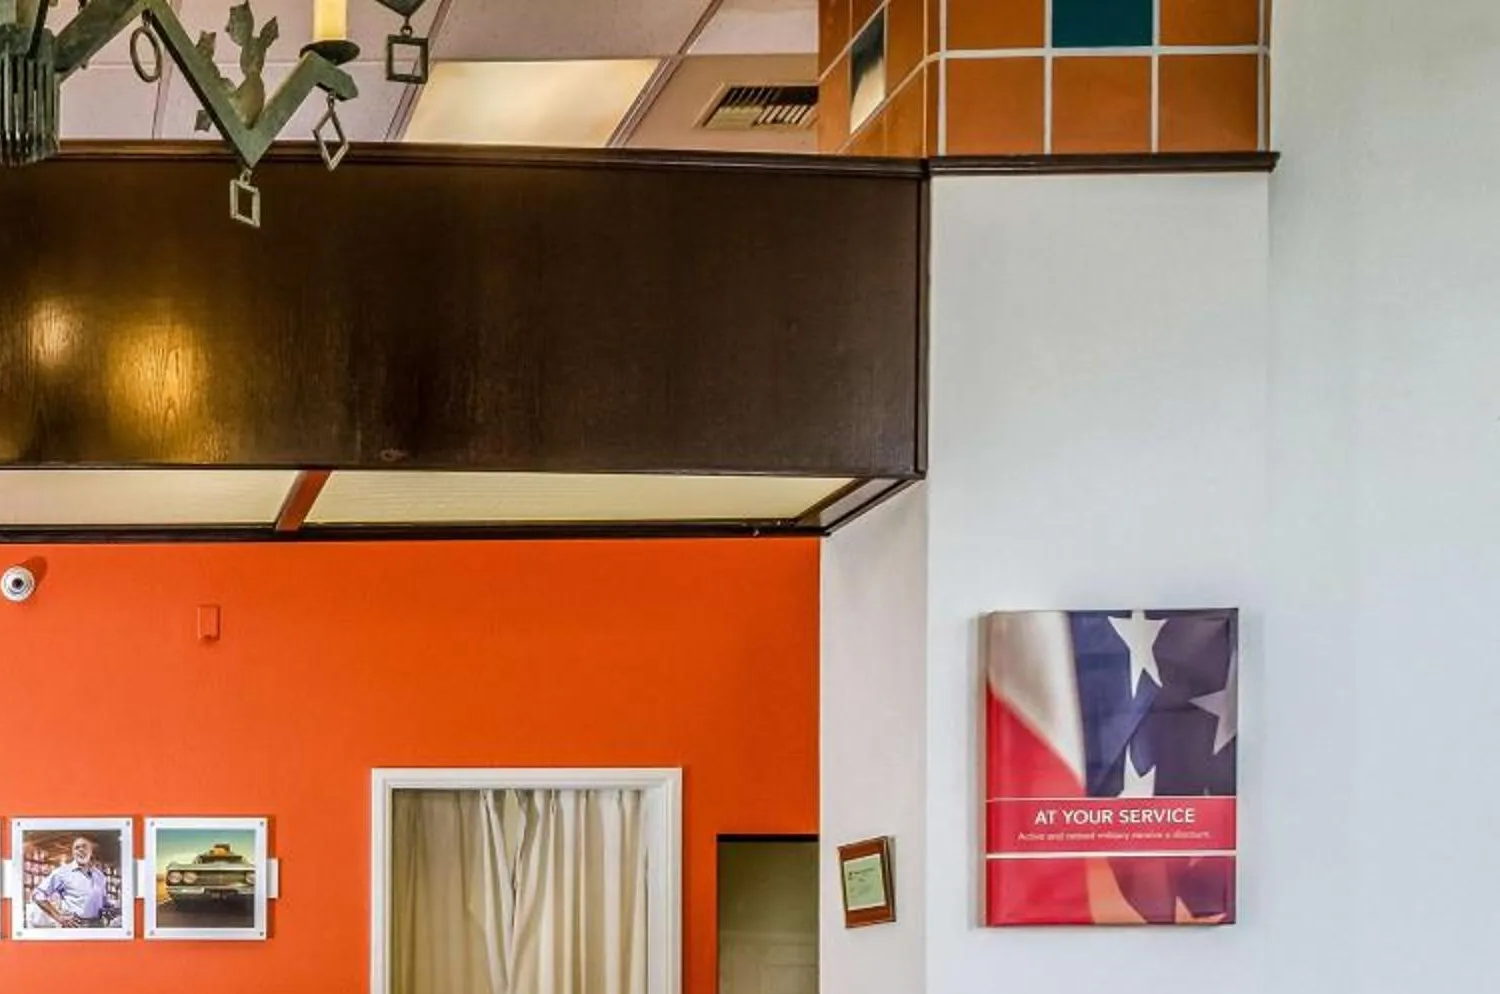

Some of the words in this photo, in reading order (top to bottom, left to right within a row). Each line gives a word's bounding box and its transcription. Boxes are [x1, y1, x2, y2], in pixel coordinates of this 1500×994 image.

[1035, 809, 1057, 824] AT
[1062, 809, 1113, 824] YOUR
[1119, 808, 1196, 824] SERVICE
